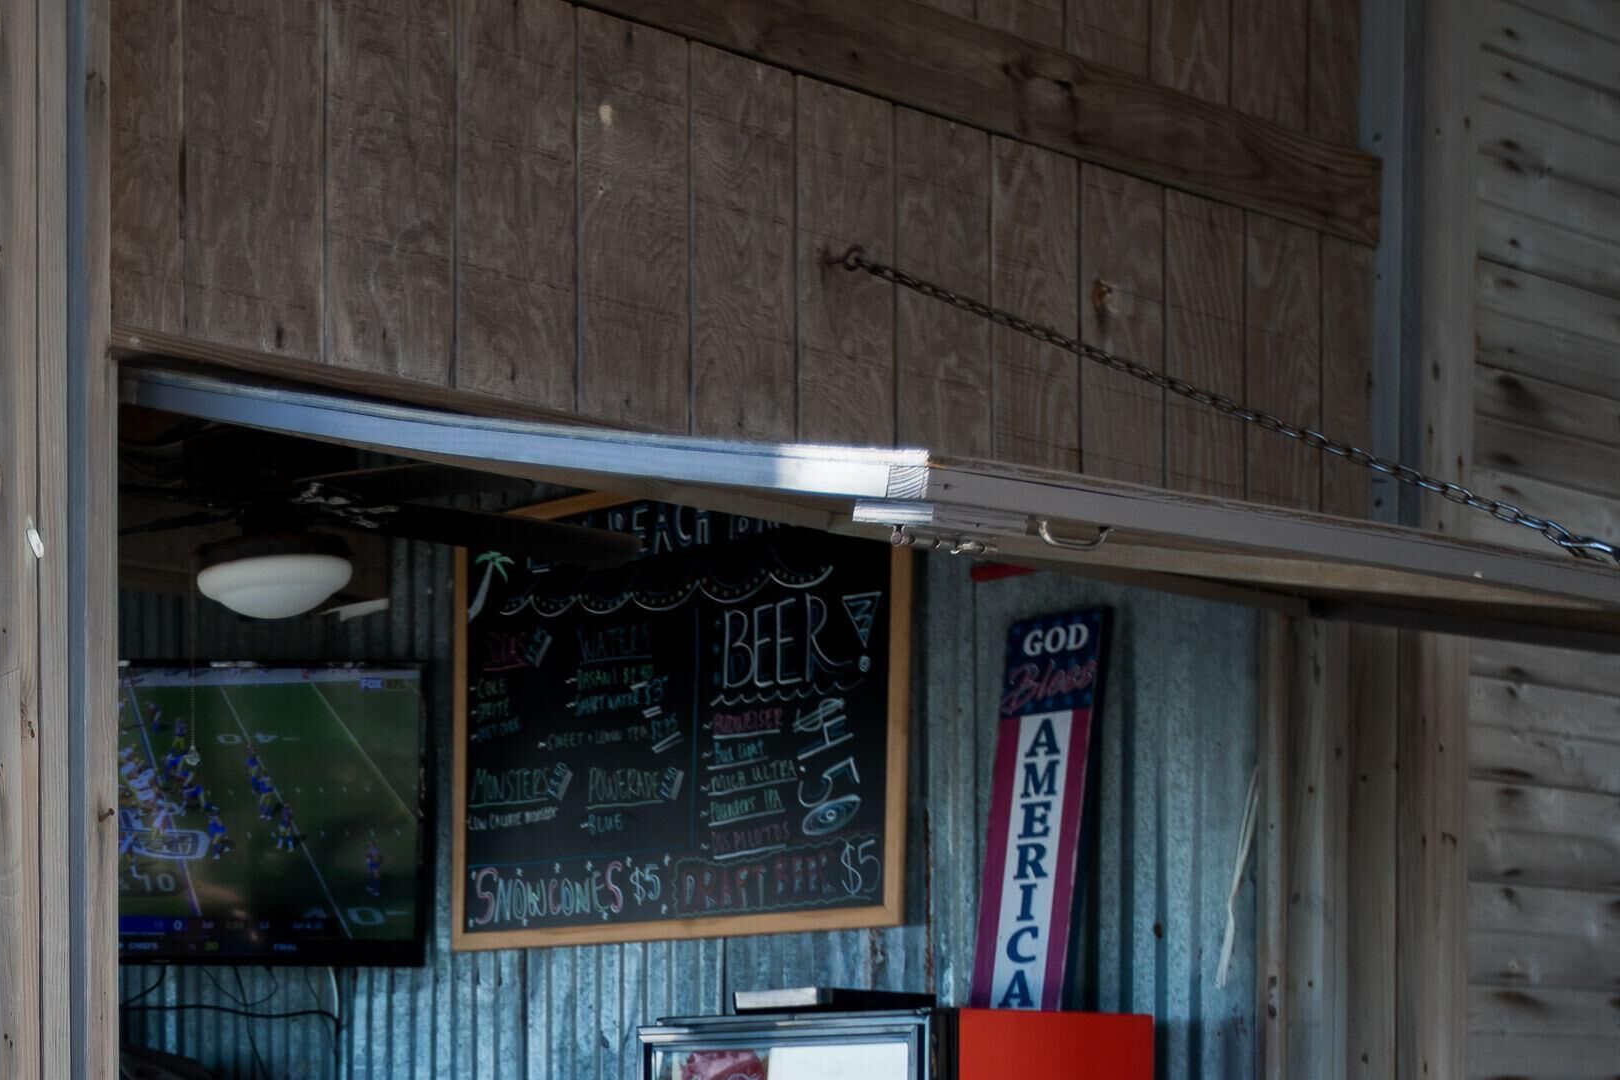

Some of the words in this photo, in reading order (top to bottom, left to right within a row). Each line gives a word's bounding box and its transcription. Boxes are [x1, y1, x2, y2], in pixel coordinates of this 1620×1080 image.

[1023, 622, 1089, 657] GOD
[360, 678, 383, 690] FOX
[1001, 658, 1098, 716] Bless
[713, 708, 782, 734] BUDWEISER
[470, 766, 549, 803] MONSTERS
[588, 766, 660, 803] POWERADE
[751, 759, 798, 782] ULTRA
[763, 788, 784, 811] IPA
[588, 812, 624, 836] BLUE
[682, 864, 767, 912] DRAFT
[773, 849, 837, 898] BEER
[841, 839, 881, 897] $5
[998, 718, 1061, 1009] AMERICA
[474, 860, 624, 925] SNOWCONES
[629, 863, 662, 907] $5
[272, 942, 299, 952] FINAL
